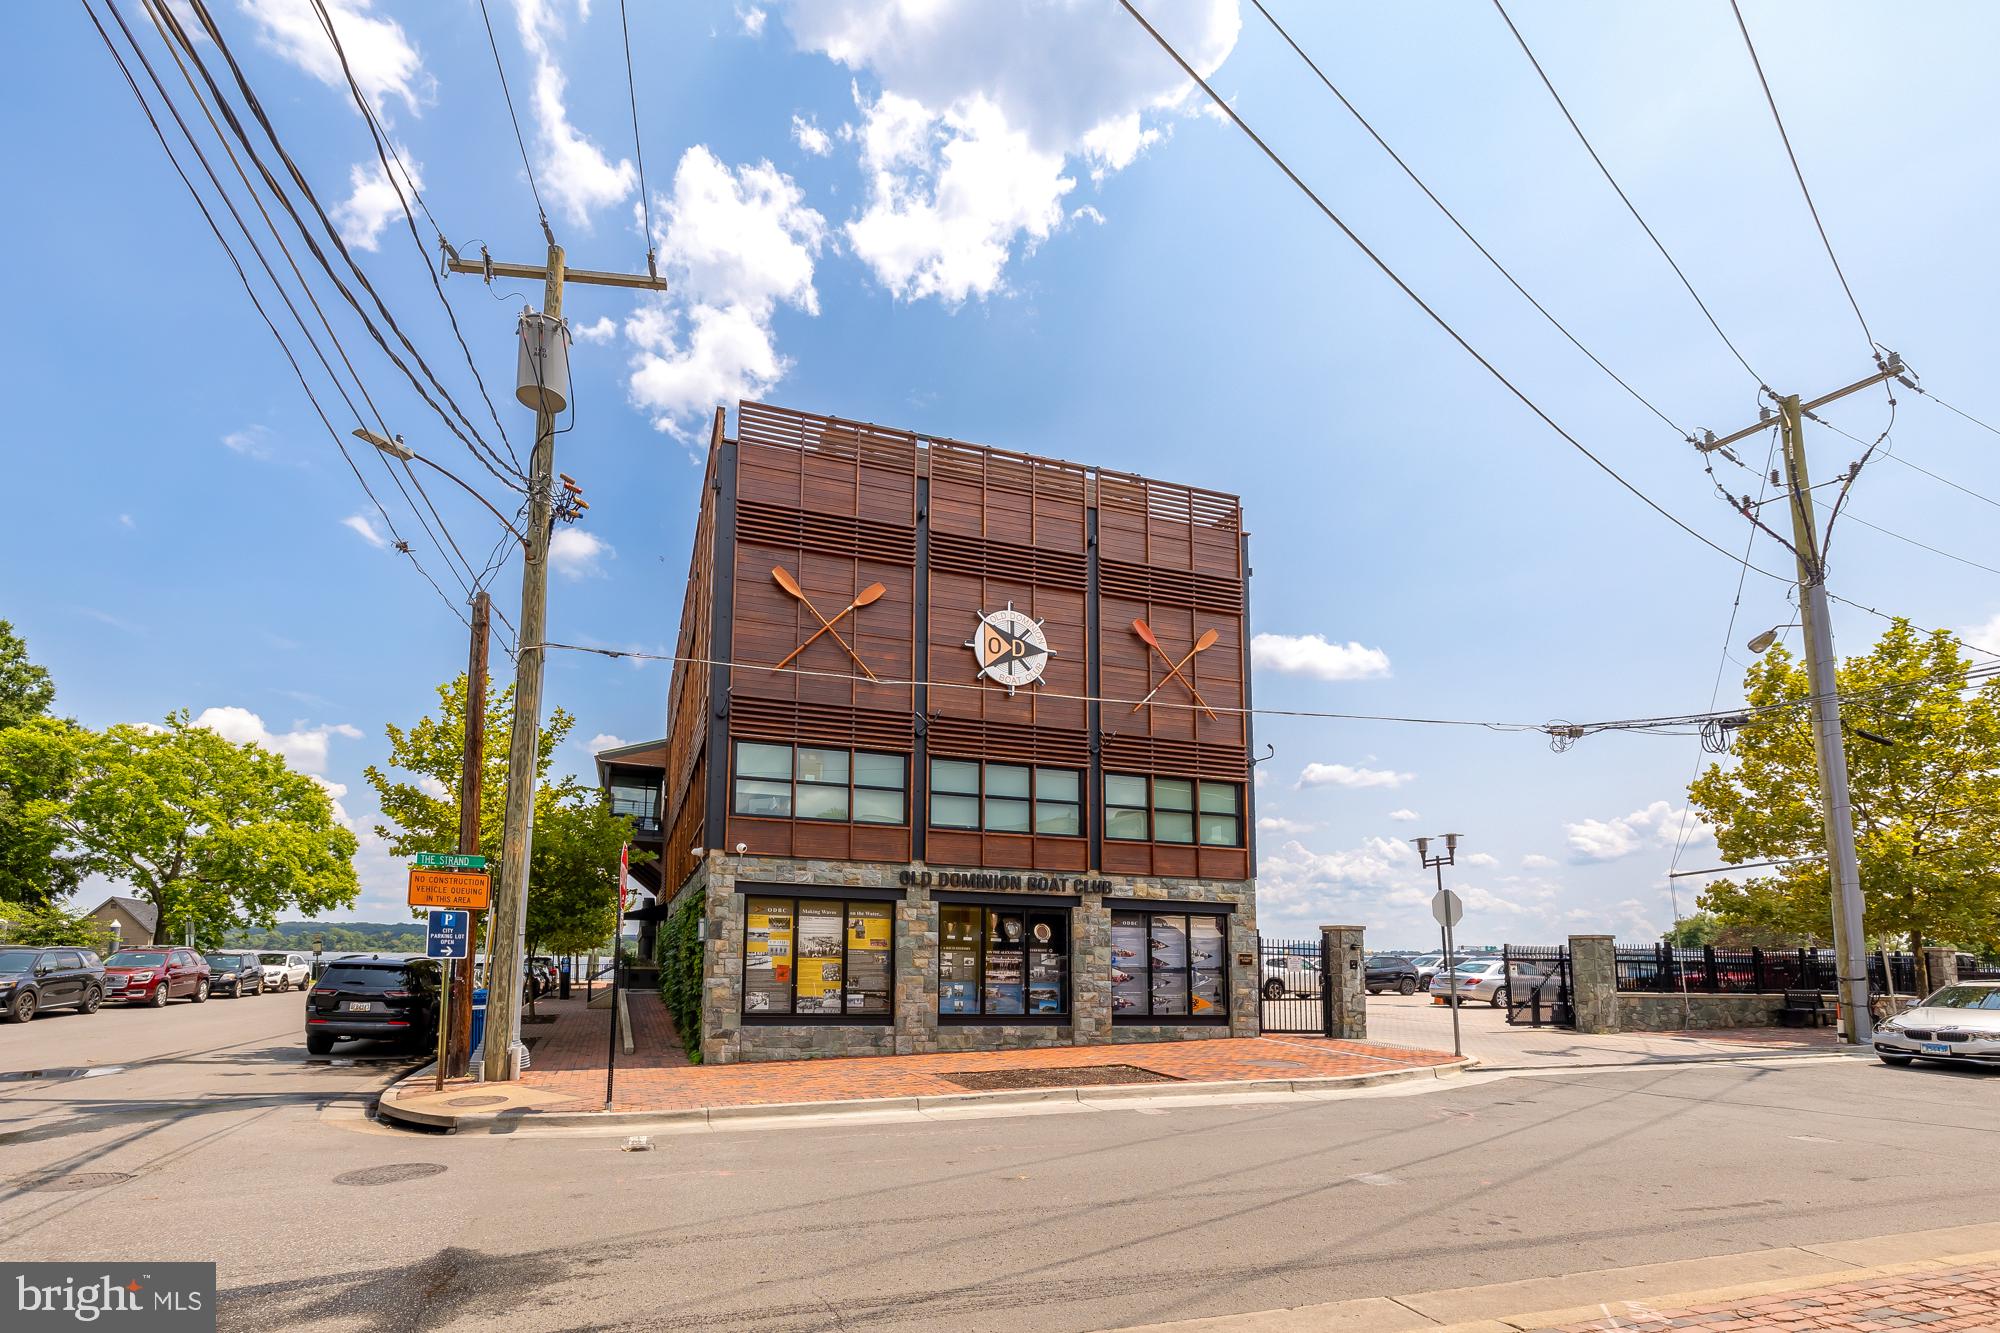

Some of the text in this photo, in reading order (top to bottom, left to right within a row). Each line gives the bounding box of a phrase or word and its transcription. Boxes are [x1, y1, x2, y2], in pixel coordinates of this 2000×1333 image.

[989, 613, 1046, 645] OLD DOMINION
[988, 637, 1025, 657] O D
[998, 662, 1044, 684] BOAT CLUB
[420, 854, 470, 866] THE STRAND
[414, 875, 485, 886] NO CONSTRUCTION
[899, 870, 1112, 894] OLD DOMINION BOAT CLUB
[416, 885, 483, 895] VEHICLE QUEUING
[444, 914, 453, 925] P
